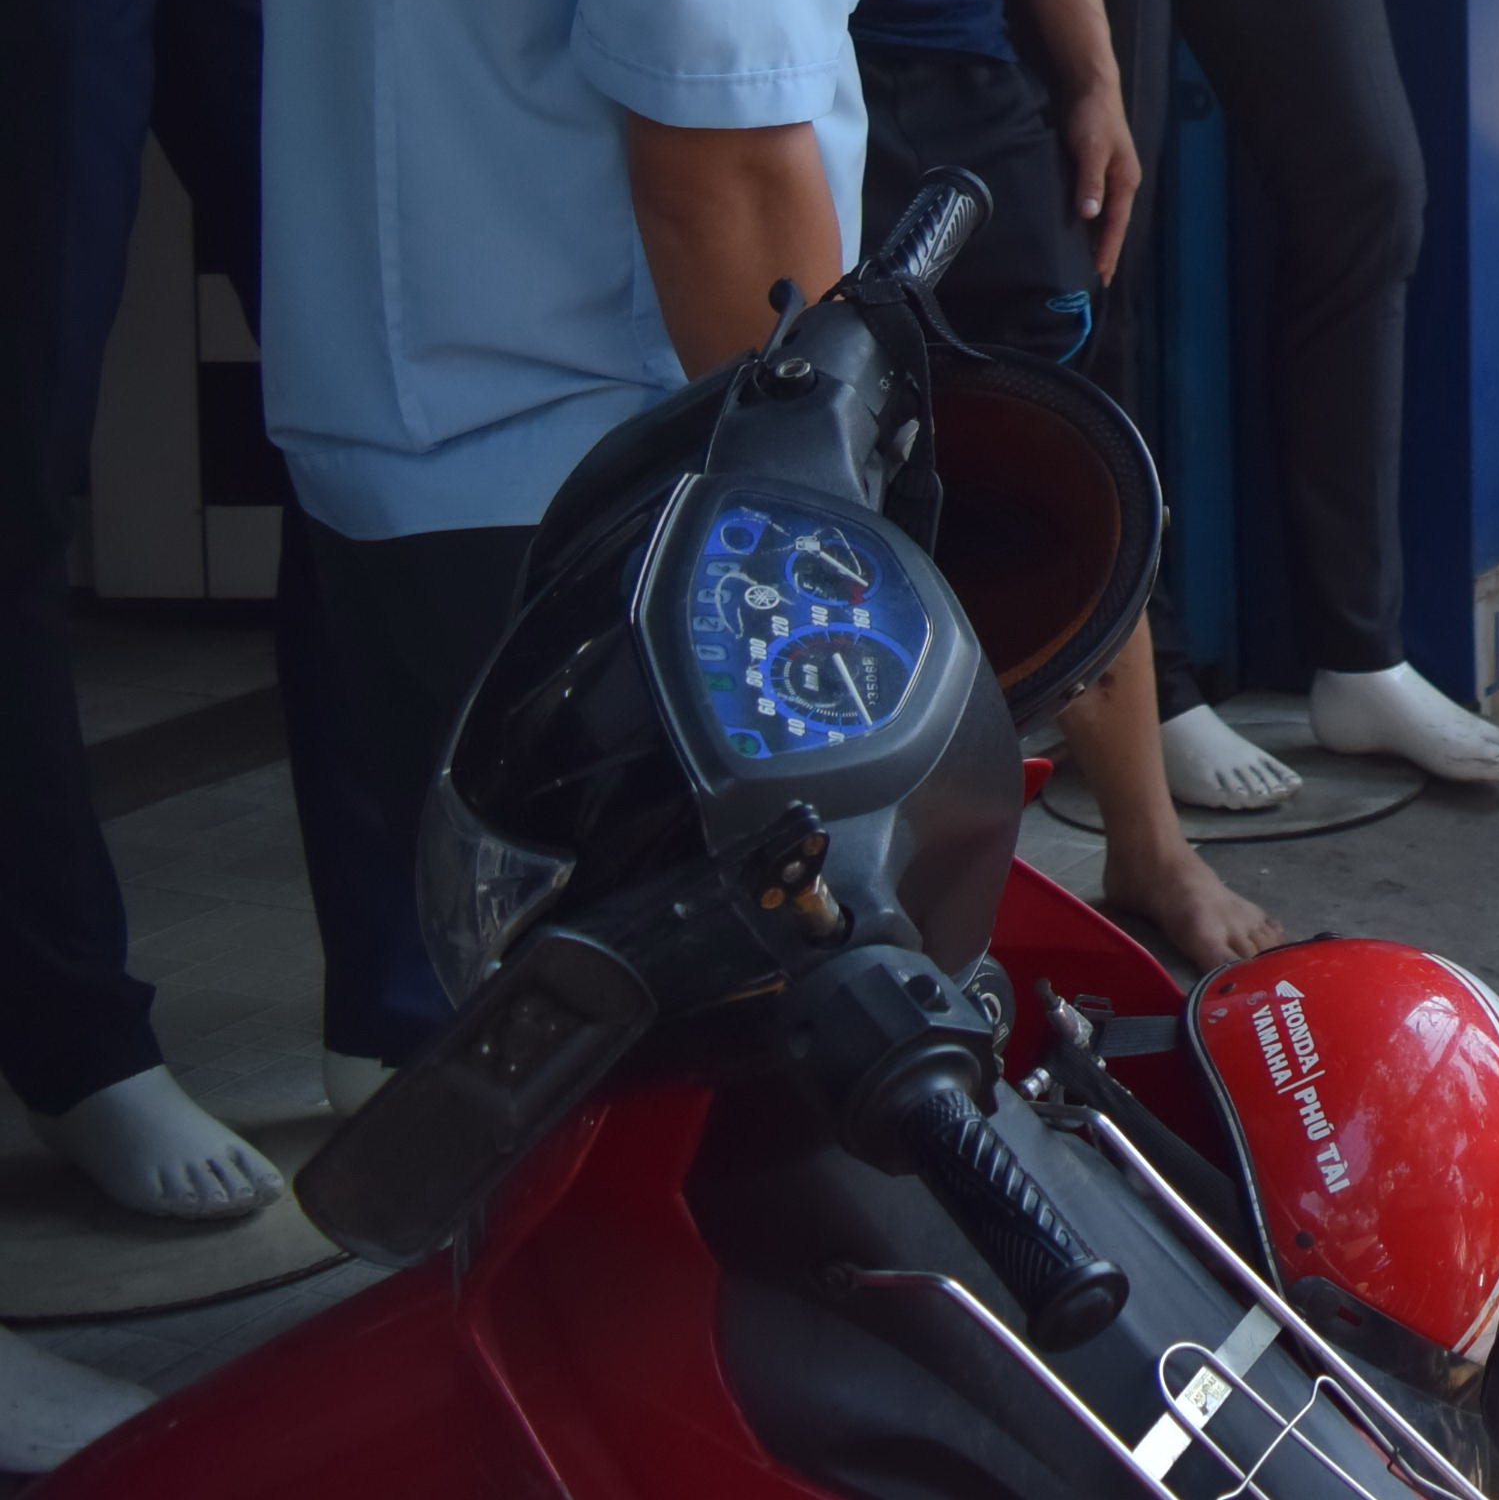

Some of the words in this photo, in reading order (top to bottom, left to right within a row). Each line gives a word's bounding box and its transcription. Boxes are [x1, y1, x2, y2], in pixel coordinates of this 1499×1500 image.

[771, 615, 790, 637] 120
[810, 604, 830, 627] 140
[852, 607, 872, 629] 160
[749, 637, 768, 661] 100
[803, 663, 820, 692] km/h
[758, 697, 776, 717] 60
[787, 717, 806, 737] 40
[1251, 1004, 1291, 1087] YAMAHA
[1281, 997, 1320, 1075] HONDA
[1293, 1084, 1335, 1142] PHÚ
